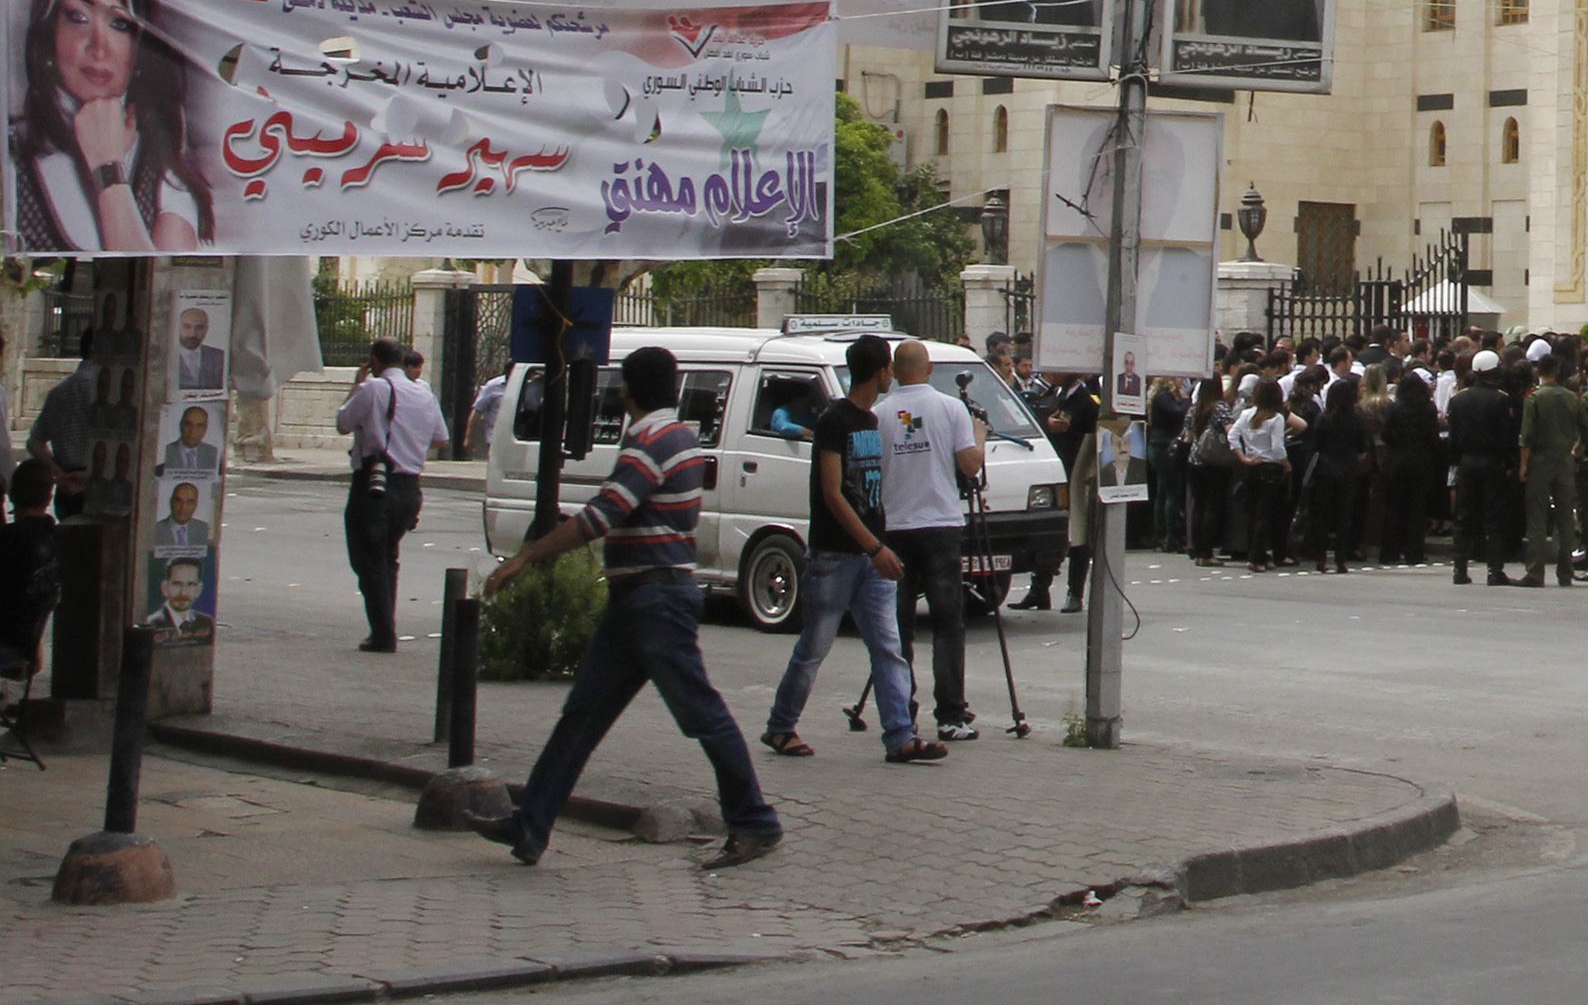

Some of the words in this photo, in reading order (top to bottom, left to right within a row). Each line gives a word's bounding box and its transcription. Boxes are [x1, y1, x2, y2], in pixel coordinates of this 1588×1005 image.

[268, 45, 412, 89] المخرجة
[416, 62, 543, 106] الإعلامية
[643, 72, 687, 100] السوري
[688, 72, 728, 102] الوطني
[729, 71, 768, 94] الشباب
[769, 77, 794, 101] حزب
[436, 136, 573, 196] سهير
[600, 157, 698, 236] مهنتي
[703, 147, 820, 238] الإعلام
[300, 220, 347, 244] الكوري
[350, 215, 400, 241] الأعمال
[400, 219, 442, 243] مركز
[445, 219, 486, 241] تقدمة
